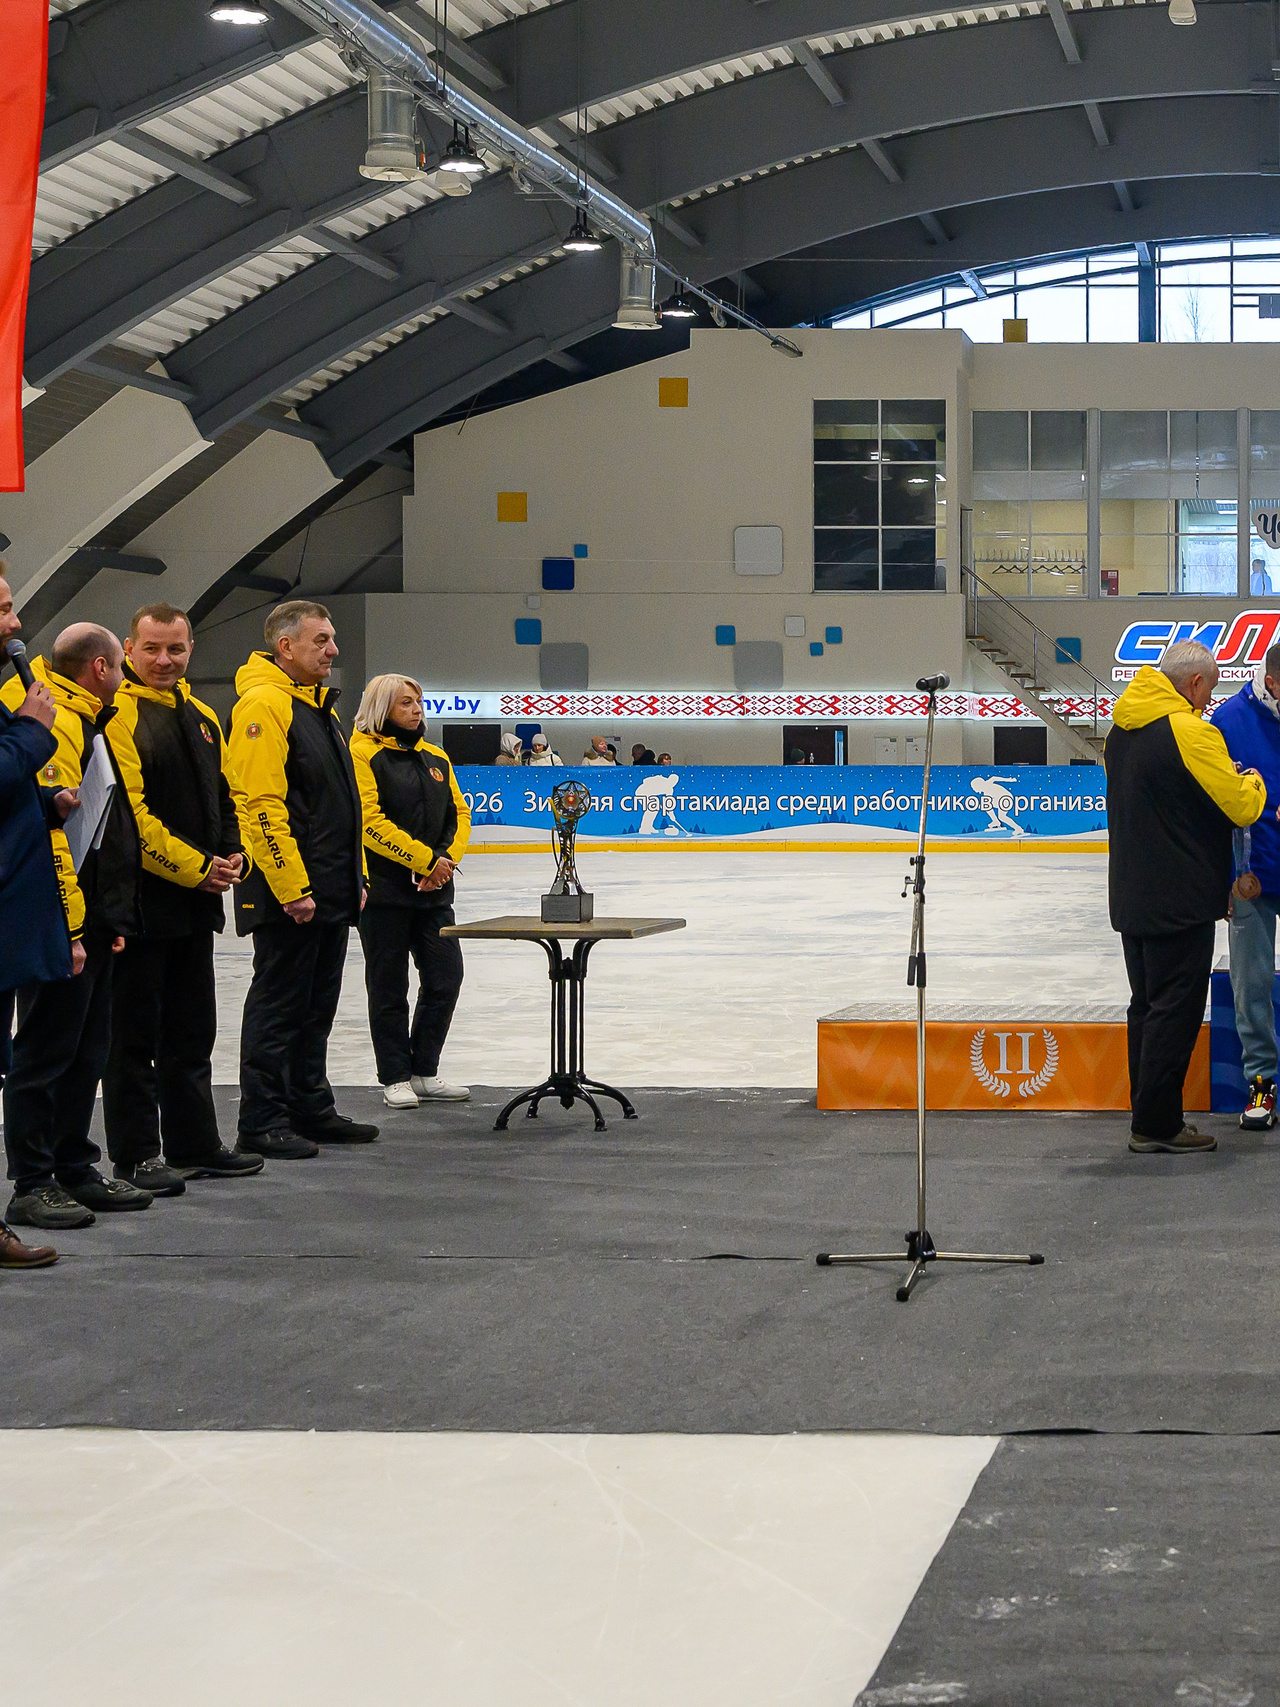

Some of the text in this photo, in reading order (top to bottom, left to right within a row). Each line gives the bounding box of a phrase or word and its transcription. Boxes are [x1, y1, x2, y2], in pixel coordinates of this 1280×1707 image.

[523, 790, 614, 813] Зияя
[619, 794, 771, 816] спартакиада
[776, 793, 846, 816] среди
[853, 789, 994, 816] работников
[257, 811, 286, 870] BELARUS
[365, 826, 414, 862] BELARUS
[993, 1032, 1036, 1074] II
